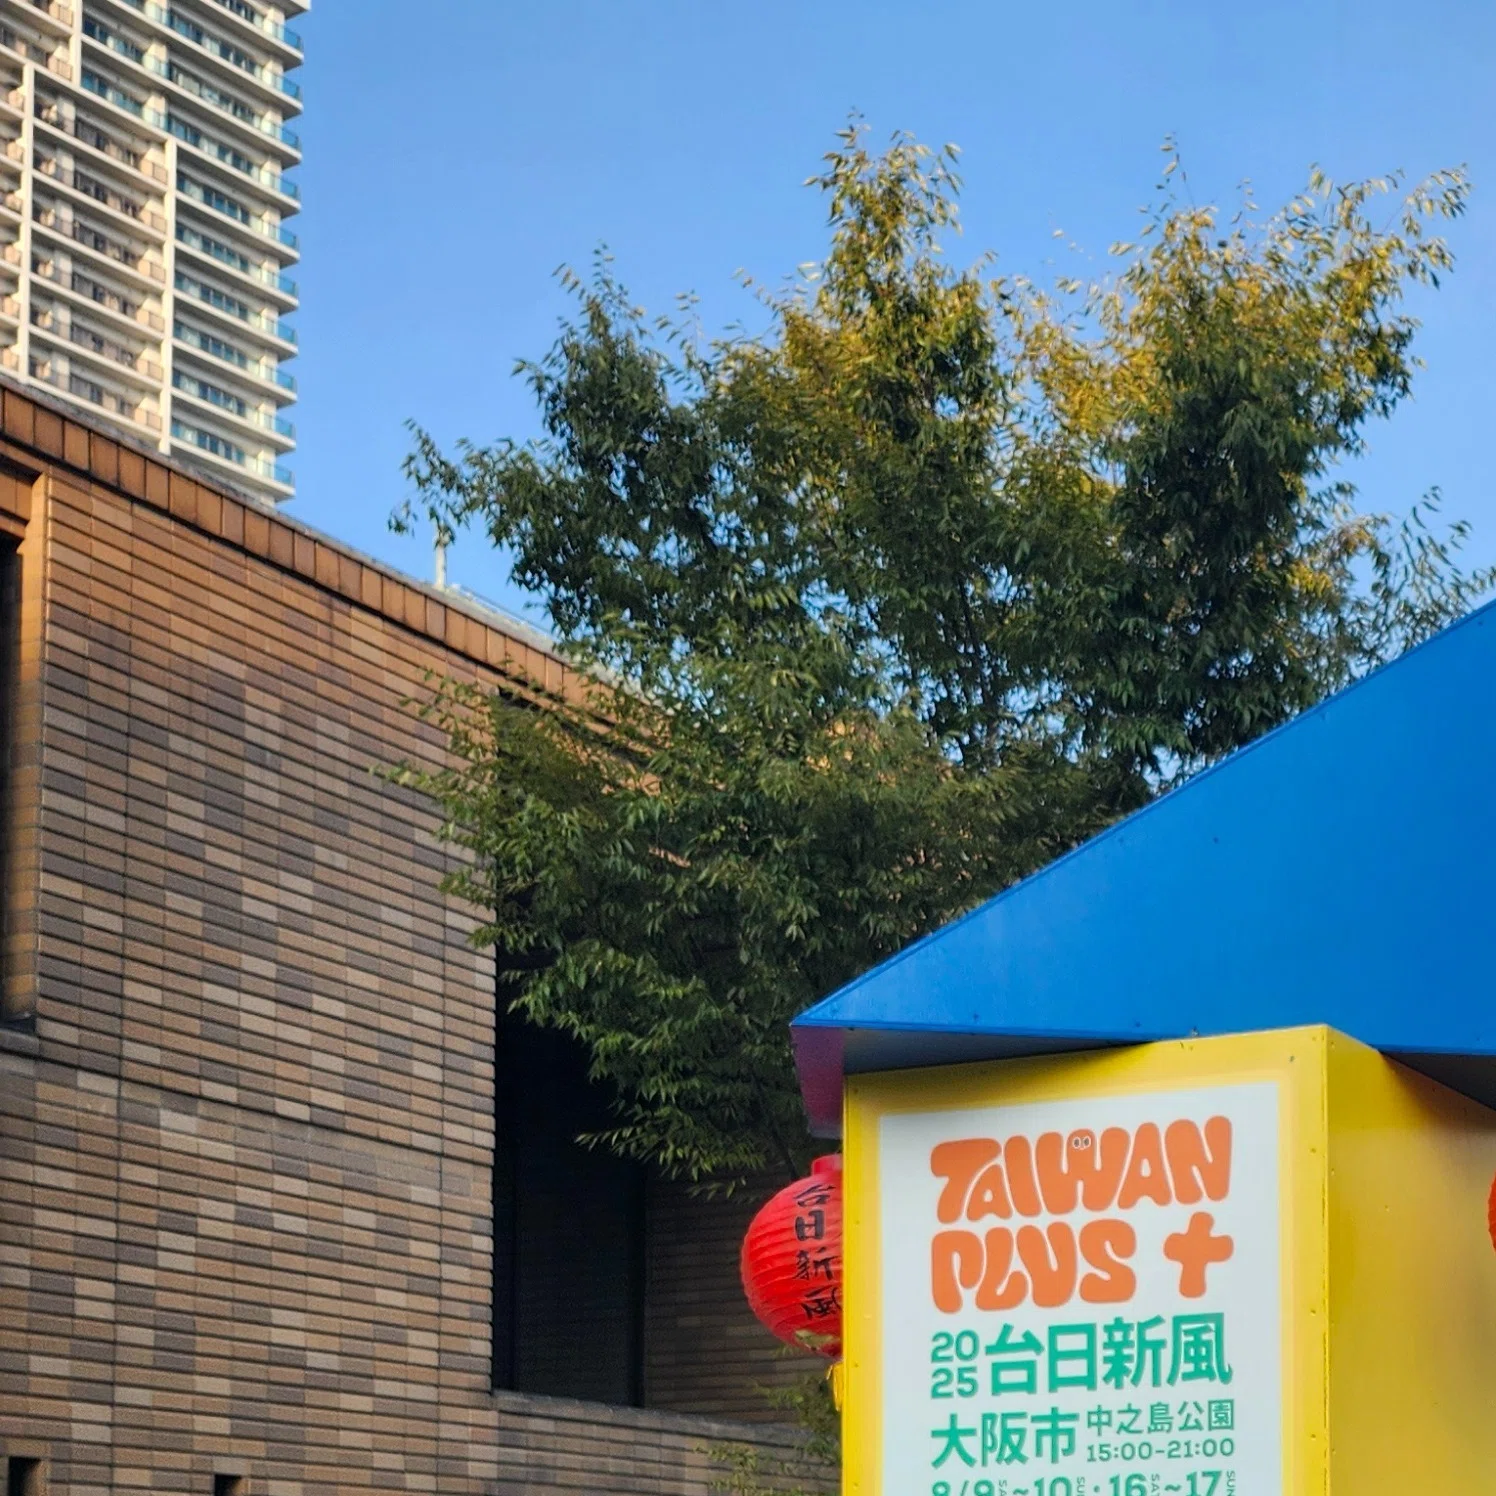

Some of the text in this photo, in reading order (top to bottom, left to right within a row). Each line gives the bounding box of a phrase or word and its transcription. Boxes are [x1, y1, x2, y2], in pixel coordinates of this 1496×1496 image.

[930, 1115, 1232, 1223] TAIWAN
[931, 1218, 1136, 1314] PLUS
[931, 1330, 979, 1363] 20
[985, 1312, 1233, 1396] 台日新風
[930, 1366, 979, 1399] 25
[930, 1406, 1079, 1469] 大阪市
[1087, 1399, 1235, 1437] 中之島公園
[1087, 1438, 1235, 1463] 15:00-21:00
